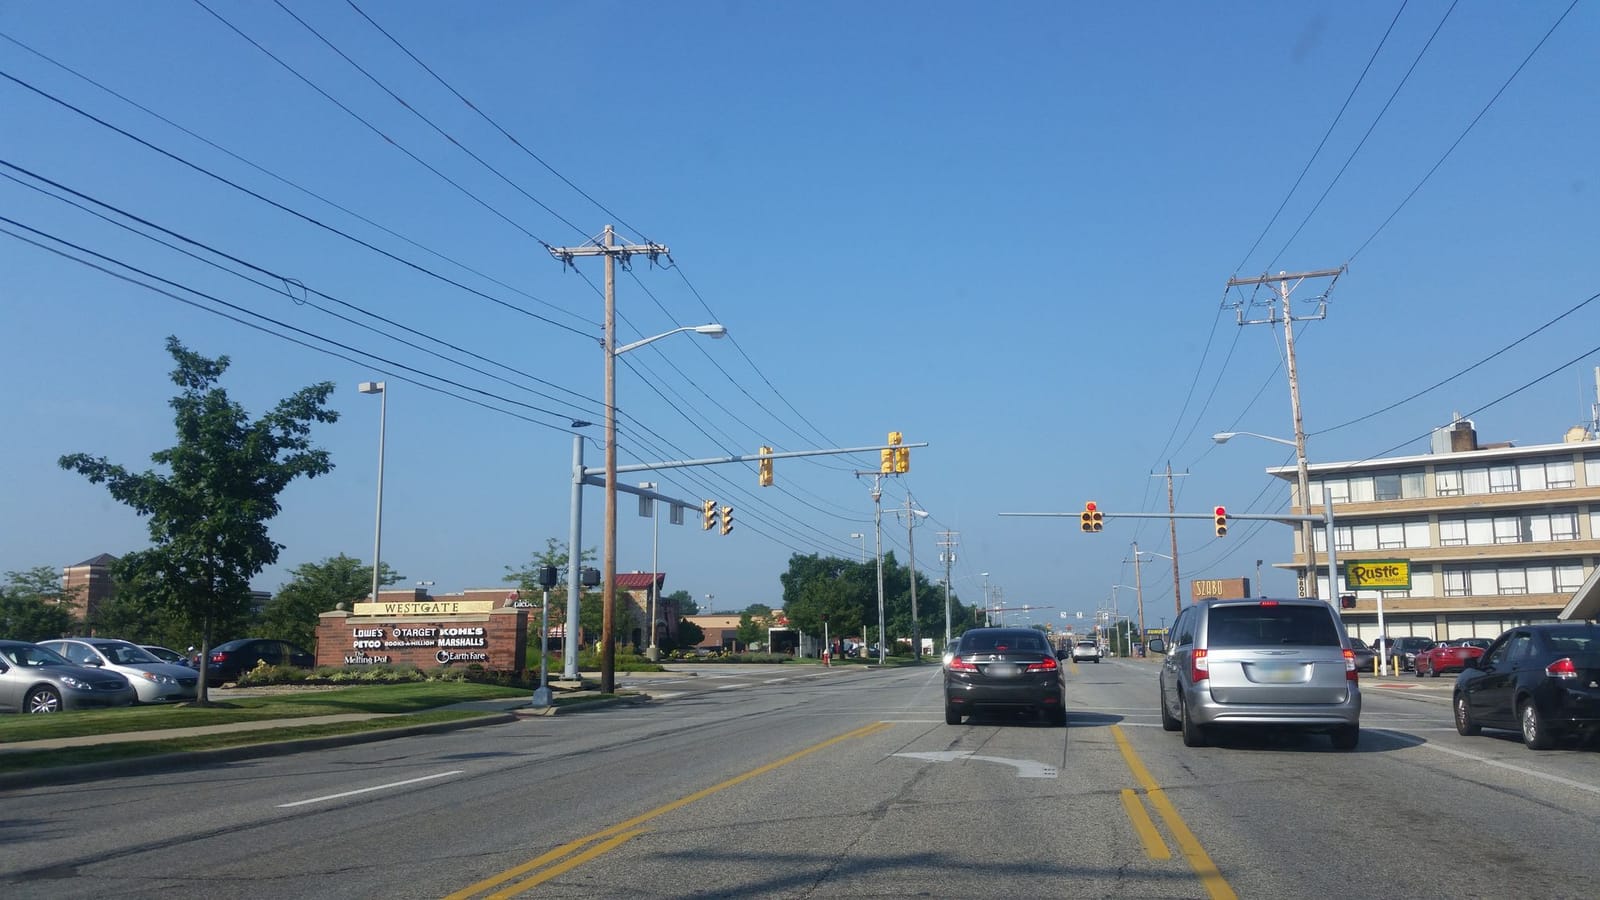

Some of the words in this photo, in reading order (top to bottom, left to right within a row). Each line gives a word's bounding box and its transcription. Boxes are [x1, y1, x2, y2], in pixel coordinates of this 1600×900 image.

[1352, 565, 1399, 584] Rustic
[1196, 580, 1223, 596] SZABO
[385, 602, 459, 613] WESTGATE
[401, 628, 436, 637] TARGET
[440, 627, 483, 636] KOHL'S
[353, 640, 381, 648] PETCO
[437, 638, 484, 647] MARSHALLS
[344, 655, 373, 665] Melting
[374, 655, 388, 663] Pot
[449, 652, 469, 660] Earth
[470, 651, 486, 660] Fare
